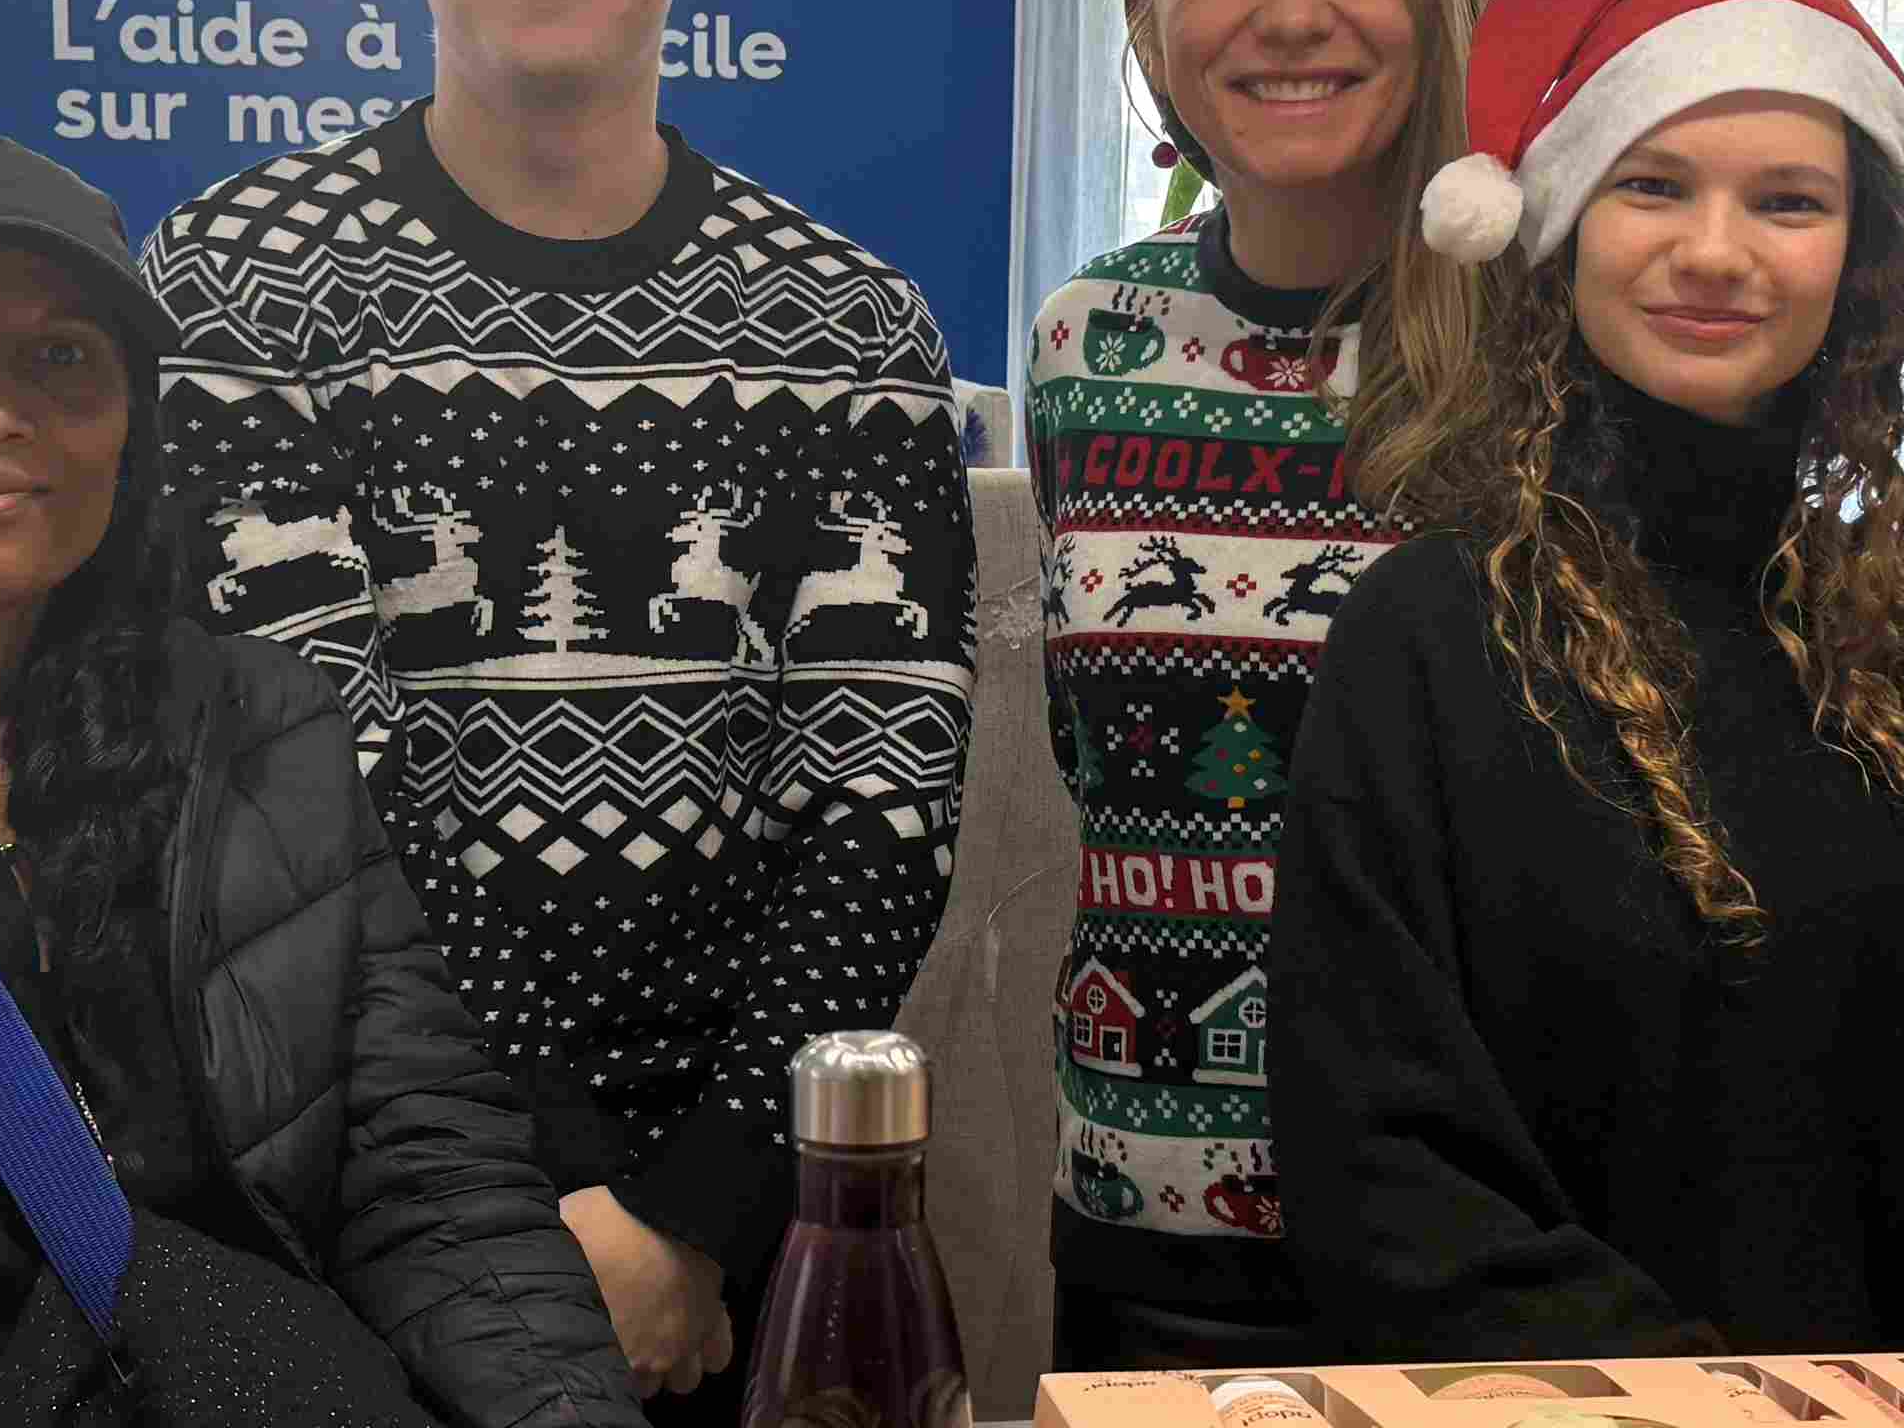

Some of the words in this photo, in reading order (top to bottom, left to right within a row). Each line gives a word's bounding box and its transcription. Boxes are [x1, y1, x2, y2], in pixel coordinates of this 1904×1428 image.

[345, 3, 403, 71] à
[658, 12, 787, 80] cile
[53, 89, 187, 141] sur
[227, 94, 414, 145] mes
[1088, 852, 1175, 910] HO!
